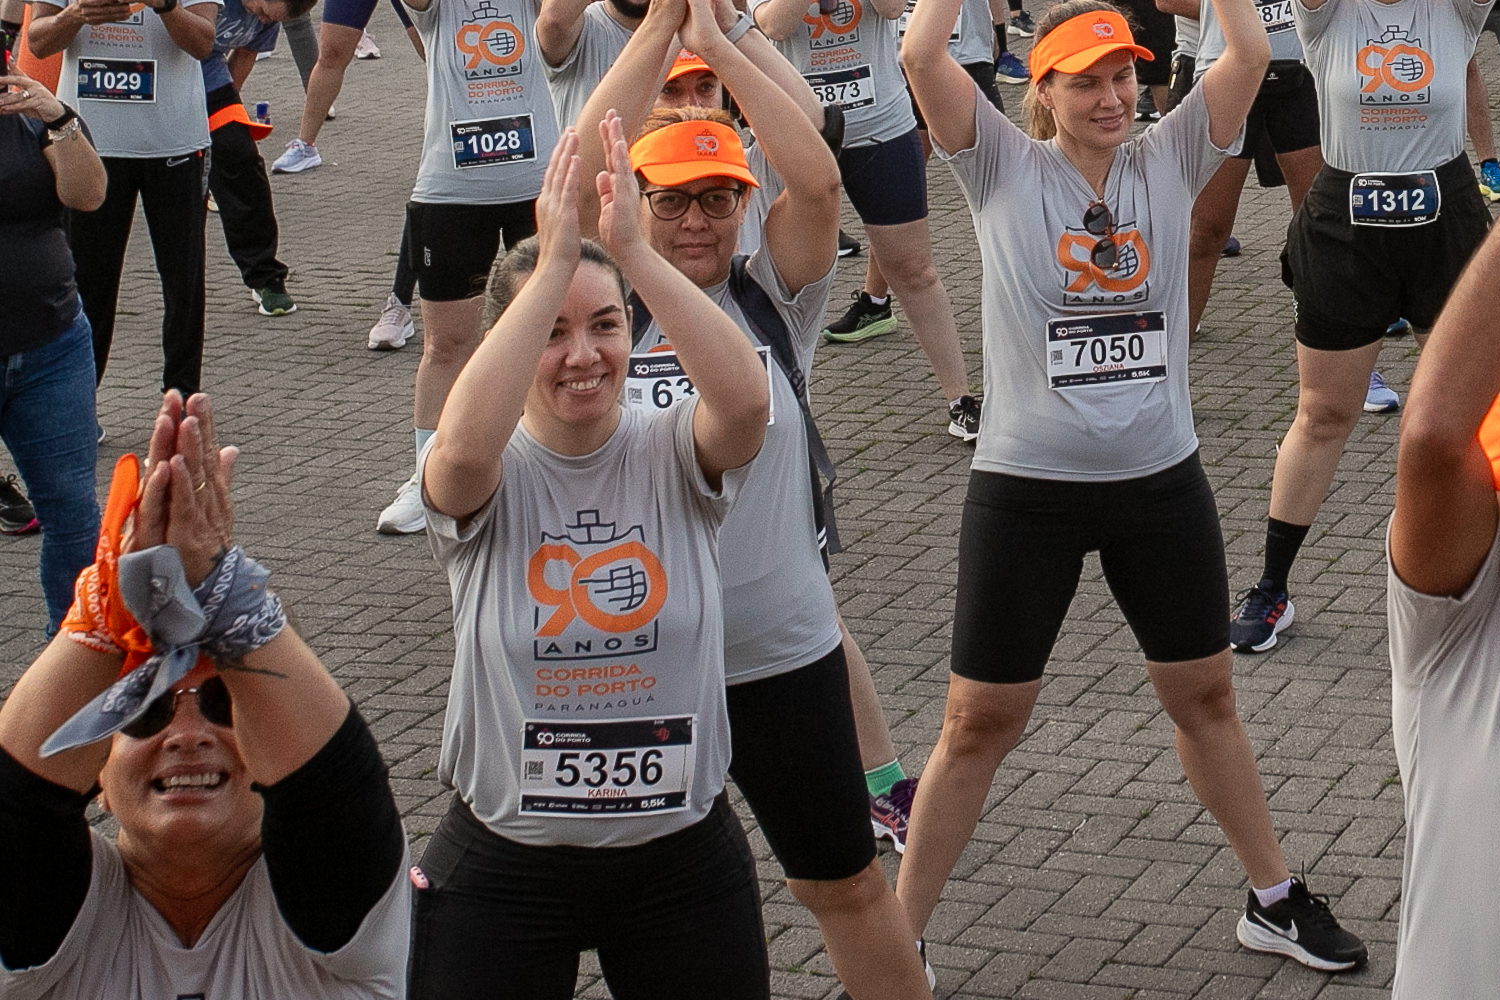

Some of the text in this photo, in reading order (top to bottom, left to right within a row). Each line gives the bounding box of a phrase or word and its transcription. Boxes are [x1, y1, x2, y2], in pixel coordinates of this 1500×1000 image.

[91, 25, 137, 34] CORRIDA
[1092, 23, 1114, 37] 90
[456, 21, 525, 70] 90
[814, 34, 856, 47] ANOS
[811, 47, 855, 59] CORRIDA
[811, 53, 861, 67] DO PORTO
[470, 65, 518, 77] ANOS
[1356, 44, 1434, 92] 90
[92, 71, 141, 90] 1029
[468, 80, 516, 90] CORRIDA
[487, 85, 523, 97] PORTO
[814, 81, 860, 102] 5873
[1365, 94, 1425, 102] ANOS
[1383, 115, 1427, 123] PORTO
[468, 130, 520, 154] 1028
[694, 136, 719, 152] 90
[1368, 189, 1425, 212] 1312
[1057, 229, 1150, 292] 90
[1071, 291, 1143, 303] ANOS
[1070, 334, 1144, 367] 7050
[634, 364, 649, 375] 90
[652, 377, 696, 409] 63
[526, 541, 668, 637] 90
[543, 633, 650, 656] ANOS
[535, 663, 642, 682] CORRIDA
[535, 676, 657, 698] DO PORTO
[537, 732, 554, 746] 90
[555, 749, 663, 788] 5356
[587, 789, 628, 797] KARINA
[641, 798, 665, 808] 5,5K
